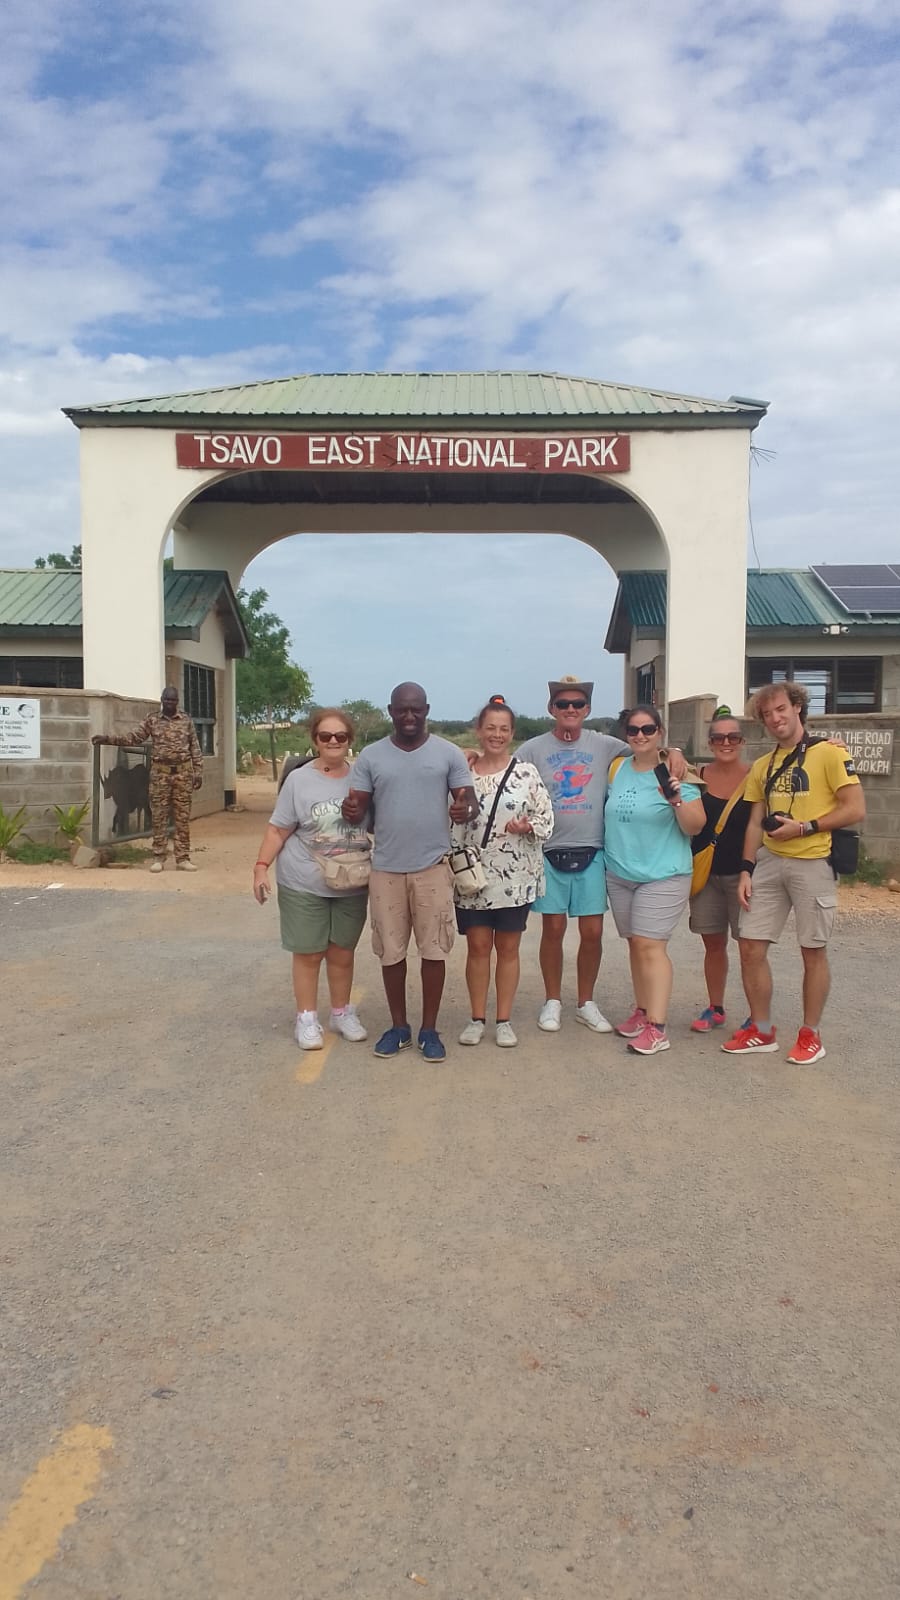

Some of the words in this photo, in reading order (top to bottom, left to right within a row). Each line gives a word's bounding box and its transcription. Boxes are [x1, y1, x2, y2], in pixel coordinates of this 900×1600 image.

[193, 435, 282, 465] TSAVO
[308, 436, 382, 465] EAST
[396, 436, 527, 468] NATIONAL
[544, 437, 619, 468] PARK
[845, 731, 864, 745] THE
[865, 732, 891, 745] ROAD
[846, 745, 862, 758] OUR
[864, 746, 883, 759] CAR
